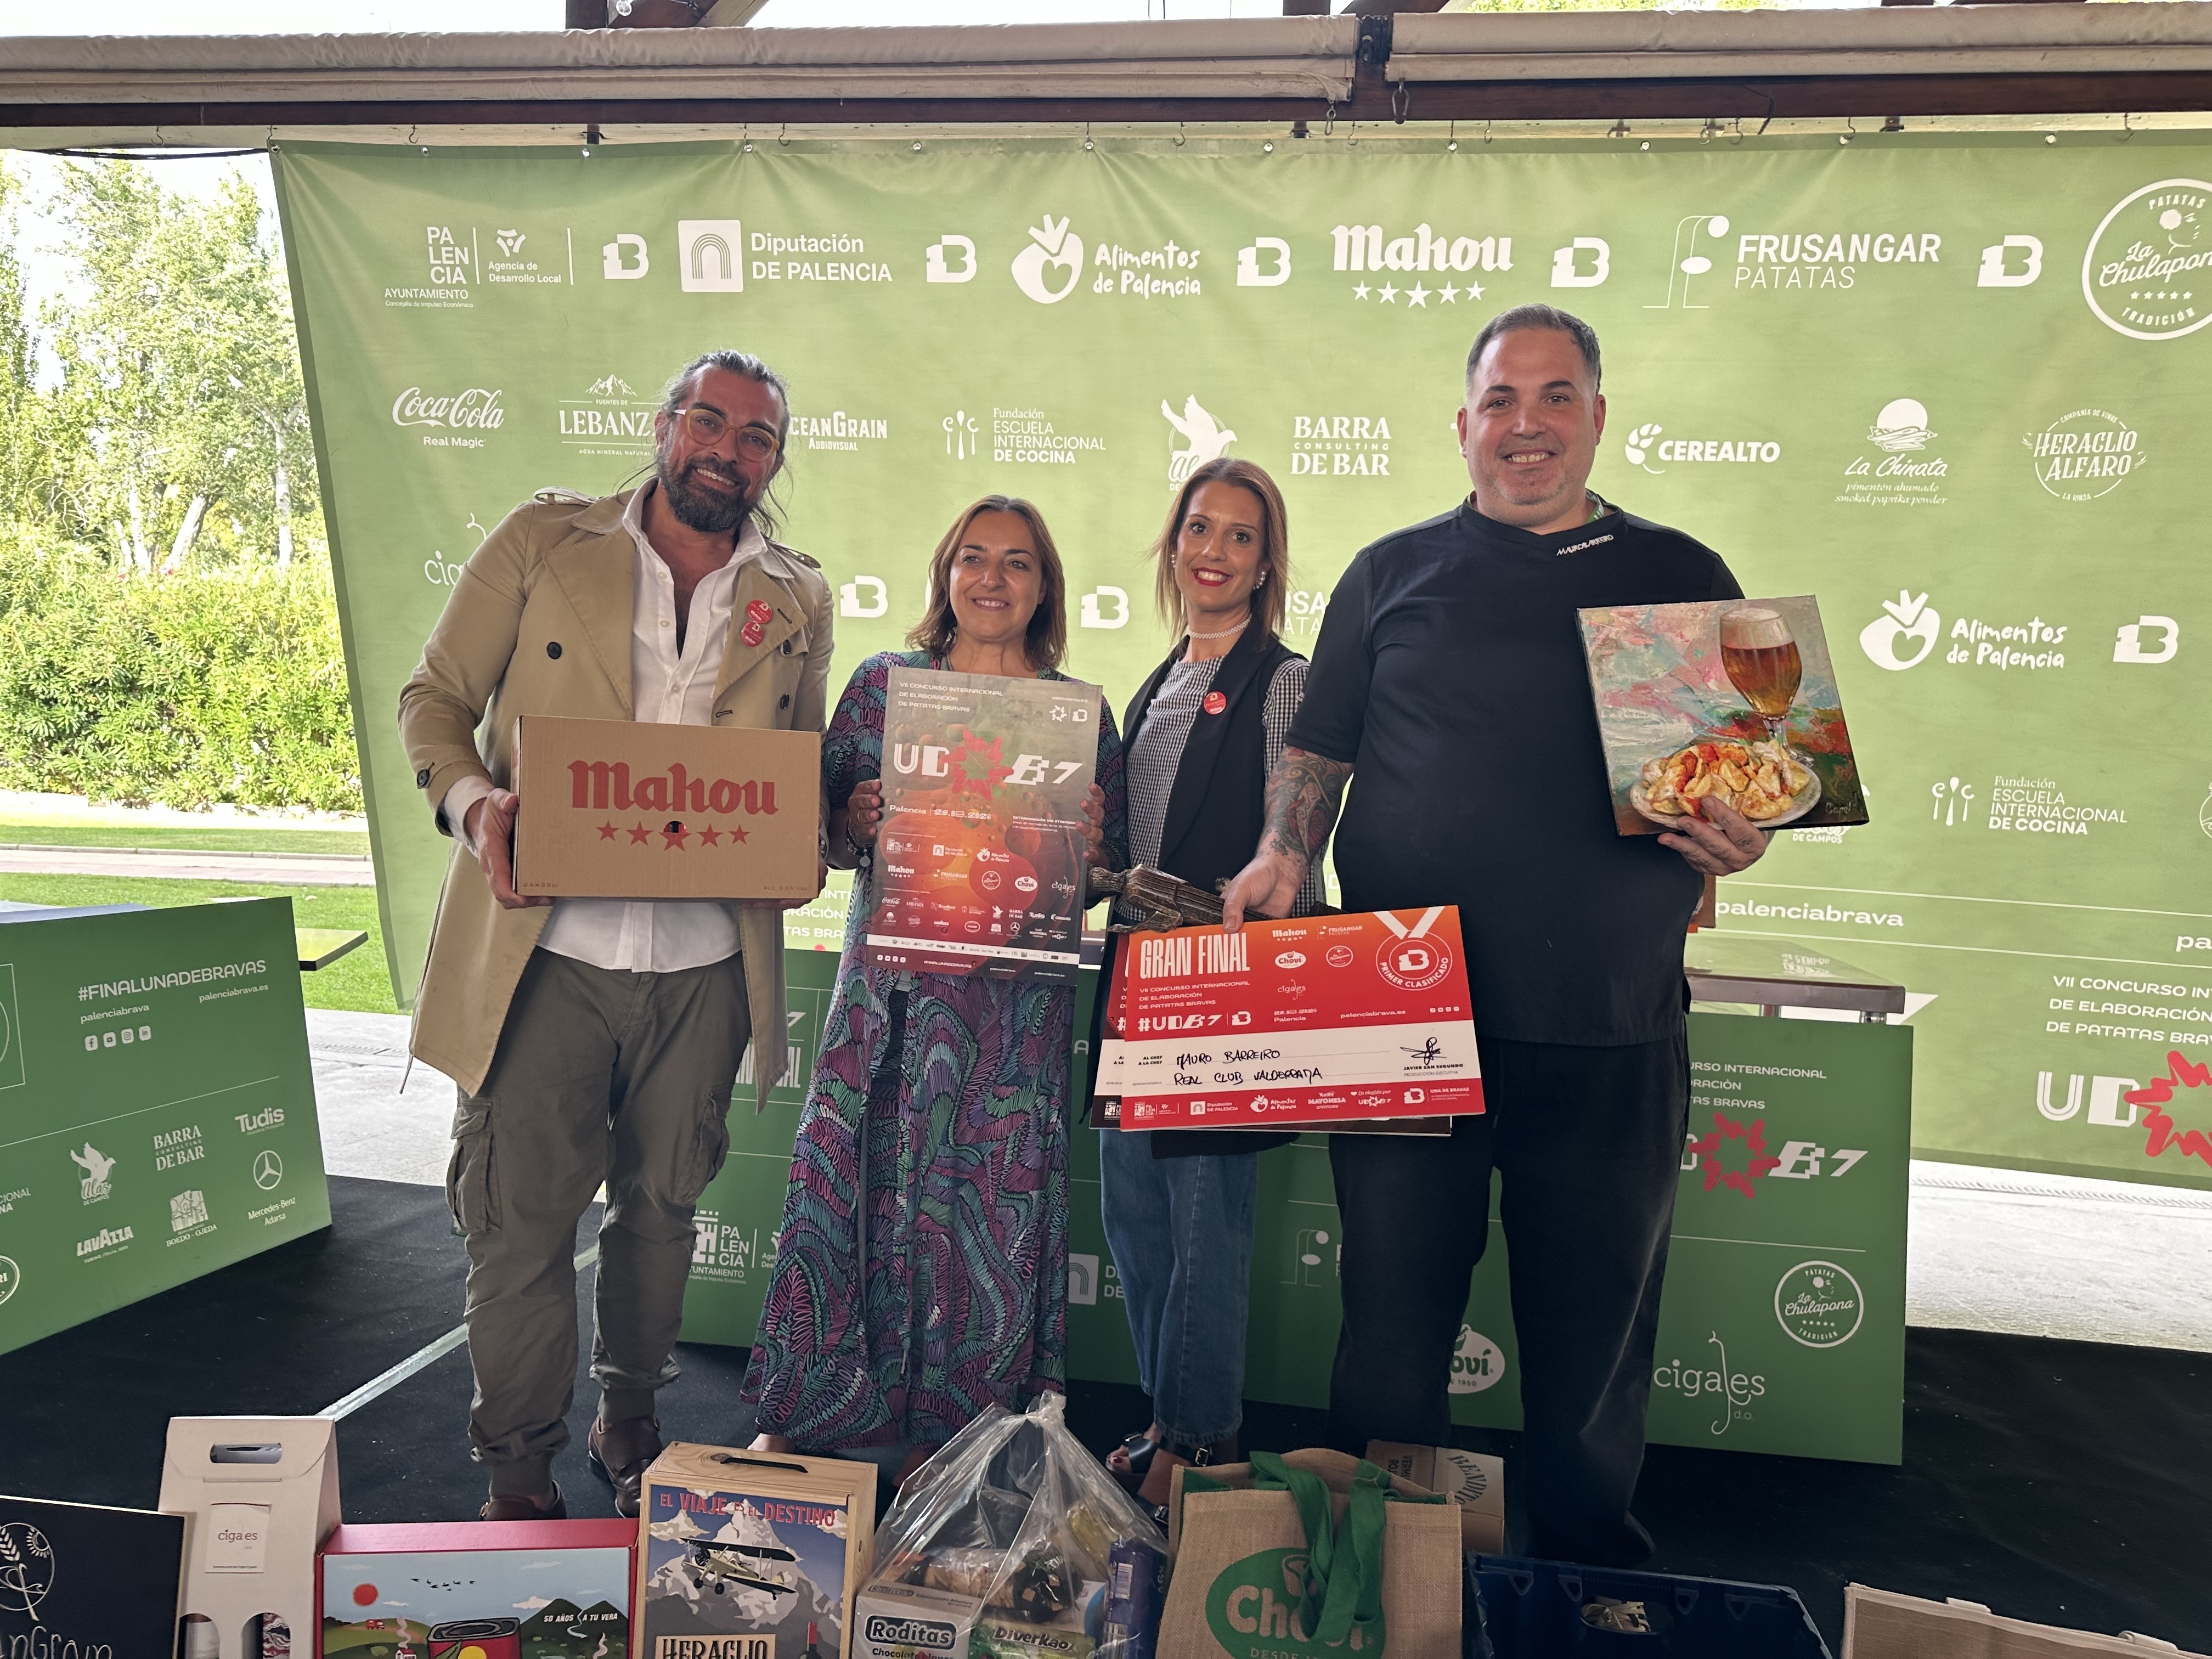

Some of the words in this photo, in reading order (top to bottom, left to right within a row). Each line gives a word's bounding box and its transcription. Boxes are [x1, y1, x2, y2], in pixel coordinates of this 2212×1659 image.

[2149, 194, 2206, 210] PATATAS
[427, 227, 454, 245] PA
[751, 232, 864, 255] Diputación
[428, 246, 469, 264] LEN
[1094, 240, 1200, 270] Alimentos
[1330, 223, 1514, 272] Mahou
[1737, 234, 1941, 263] FRUSANGAR
[2125, 241, 2155, 262] La
[430, 266, 466, 284] CIA
[488, 261, 524, 271] Agencia
[527, 262, 538, 270] de
[753, 262, 780, 279] DE
[787, 262, 893, 281] PALENCIA
[2099, 250, 2212, 287] Chulapon
[489, 273, 535, 283] Desarrollo
[537, 274, 561, 283] Local
[1093, 272, 1113, 294] de
[1120, 269, 1201, 300] Palencia
[1735, 267, 1855, 289] PATATAS
[385, 288, 468, 299] AYUNTAMIENTO
[2121, 307, 2195, 326] TRADICIÓN
[392, 387, 505, 428] Coca-Cola
[993, 408, 1043, 419] Fundación
[560, 409, 653, 437] LEBANZ
[994, 421, 1053, 435] ESCUELA
[1294, 416, 1392, 439] BARRA
[423, 436, 449, 447] Real
[451, 437, 485, 448] Magic
[994, 436, 1106, 451] INTERNACIONAL
[1294, 443, 1390, 451] CONSULTING
[2033, 431, 2137, 457] HERACLIO
[994, 449, 1012, 462] DE
[1015, 450, 1075, 464] COCINA
[1658, 441, 1781, 463] CEREALTO
[1290, 453, 1327, 475] DE
[1333, 454, 1390, 476] BAR
[1844, 456, 1869, 476] La
[1876, 454, 1949, 477] Chinata
[2044, 455, 2131, 481] ALFARO
[1846, 482, 1892, 494] pimentón
[1893, 482, 1939, 493] ahumado
[1835, 494, 1869, 504] smoked
[1872, 493, 1909, 506] paprika
[1910, 494, 1948, 505] powder
[1951, 617, 2068, 645] Alimentos
[1946, 645, 1968, 665] de
[1976, 645, 2065, 671] Palencia
[910, 693, 958, 701] ELABORACIÓN
[949, 686, 1003, 696] INTERNACIONAL
[909, 702, 941, 710] PATATAS
[567, 760, 780, 815] Mahou
[1994, 775, 2056, 788] Fundación
[1992, 787, 2065, 806] ESCUELA
[889, 804, 926, 815] Palencia
[1991, 803, 2127, 823] INTERNACIONAL
[1989, 817, 2012, 831] DE
[2015, 819, 2088, 836] COCINA
[1792, 833, 1804, 842] DE
[1806, 834, 1842, 844] CAMPOS
[888, 865, 915, 874] Mahou
[1716, 899, 1904, 927] palenciabrava
[1272, 929, 1307, 938] Mahou
[1140, 937, 1192, 979] GRAN
[1198, 933, 1250, 974] FINAL
[78, 960, 267, 1002] #FINALUNADEBRAVAS
[1380, 961, 1403, 986] PRIMER
[1404, 957, 1449, 988] CLASIFICADO
[199, 983, 268, 1003] palenciabrava.es
[1192, 981, 1250, 989] INTERNACIONAL
[2053, 976, 2074, 989] VII
[2079, 977, 2186, 997] CONCURSO
[1151, 992, 1203, 1000] ELABORACIÓN
[2050, 998, 2073, 1011] DE
[80, 1004, 150, 1024] palenciabrava
[1340, 1010, 1406, 1019] palenciabrava.es
[2046, 1022, 2069, 1033] DE
[2076, 1023, 2164, 1045] PATATAS
[1177, 1053, 1212, 1070] MAURO
[1223, 1049, 1280, 1064] BARREIRO
[1174, 1073, 1203, 1086] REAL
[1214, 1072, 1243, 1085] CLUB
[1724, 1063, 1827, 1080] INTERNACIONAL
[1713, 1096, 1765, 1110] BRAVAS
[235, 1108, 285, 1133] Tudis
[154, 1125, 202, 1149] BARRA
[156, 1154, 175, 1171] DE
[177, 1146, 205, 1165] BAR
[248, 1197, 296, 1220] Mercedes-Benz
[264, 1213, 286, 1226] Adarsa
[77, 1226, 134, 1256] LAVAZZA
[1805, 1268, 1835, 1278] PATATAS
[1785, 1300, 1854, 1317] Chulapona
[661, 1493, 673, 1508] EL
[679, 1493, 727, 1515] VIAJE
[734, 1502, 744, 1511] ES
[748, 1506, 758, 1517] EL
[765, 1503, 835, 1527] DESTINO
[555, 1613, 574, 1622] AÑOS
[601, 1612, 618, 1621] VERA
[871, 1621, 951, 1646] Roditas
[994, 1626, 1073, 1650] Diverkao
